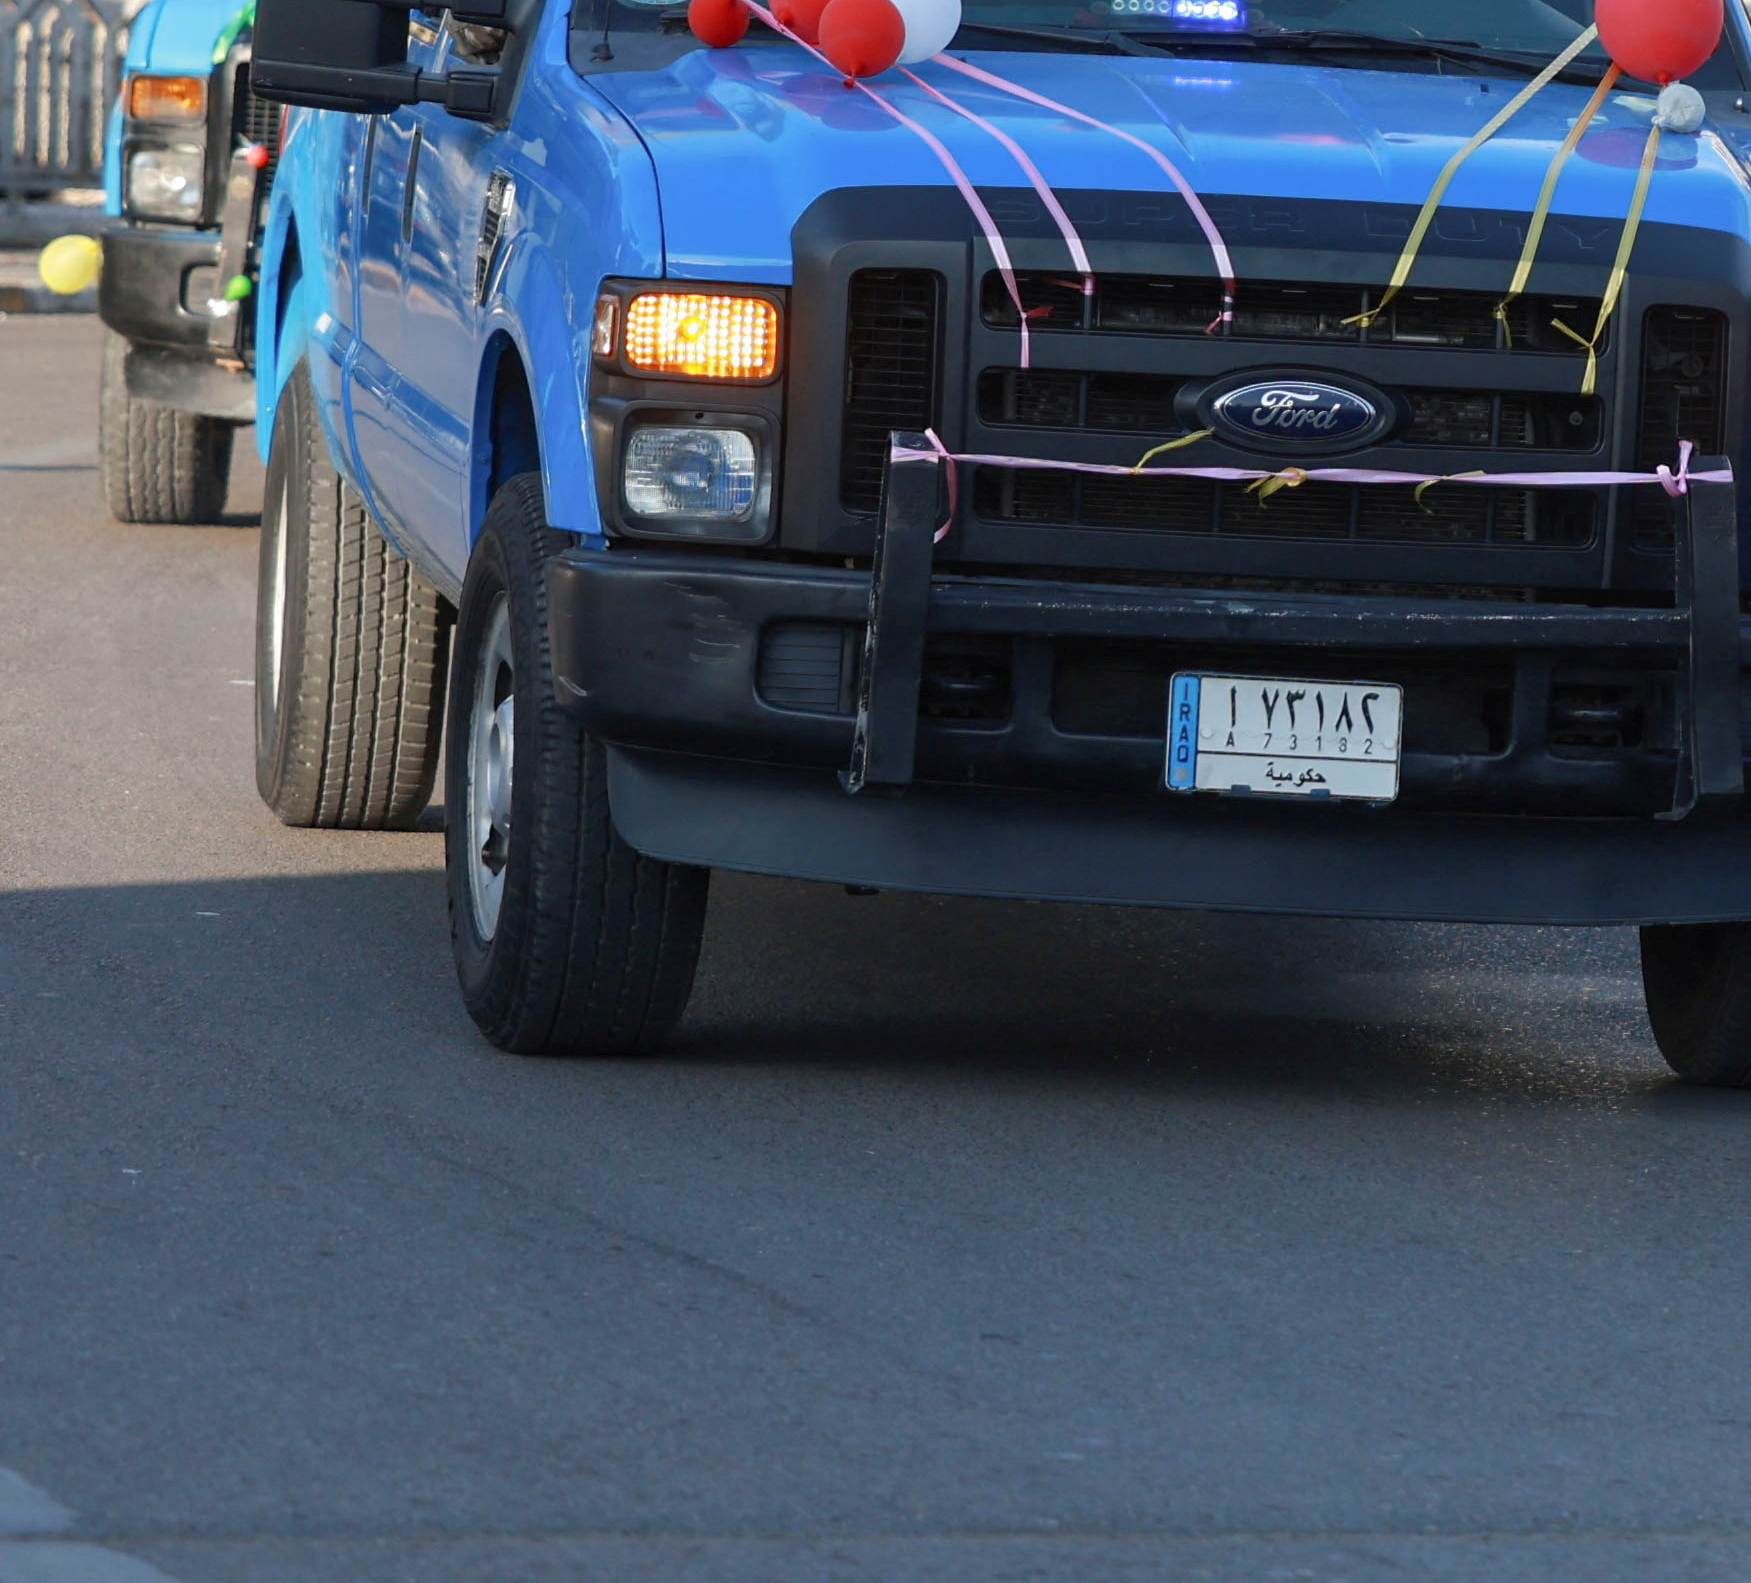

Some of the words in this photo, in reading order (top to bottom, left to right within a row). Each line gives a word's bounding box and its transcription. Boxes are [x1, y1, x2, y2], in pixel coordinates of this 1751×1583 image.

[1252, 390, 1341, 430] Ford
[1176, 681, 1193, 763] IRAQ
[1260, 686, 1380, 735] ٧٣١٨٢
[1225, 730, 1235, 747] A
[1264, 760, 1327, 788] حكومية
